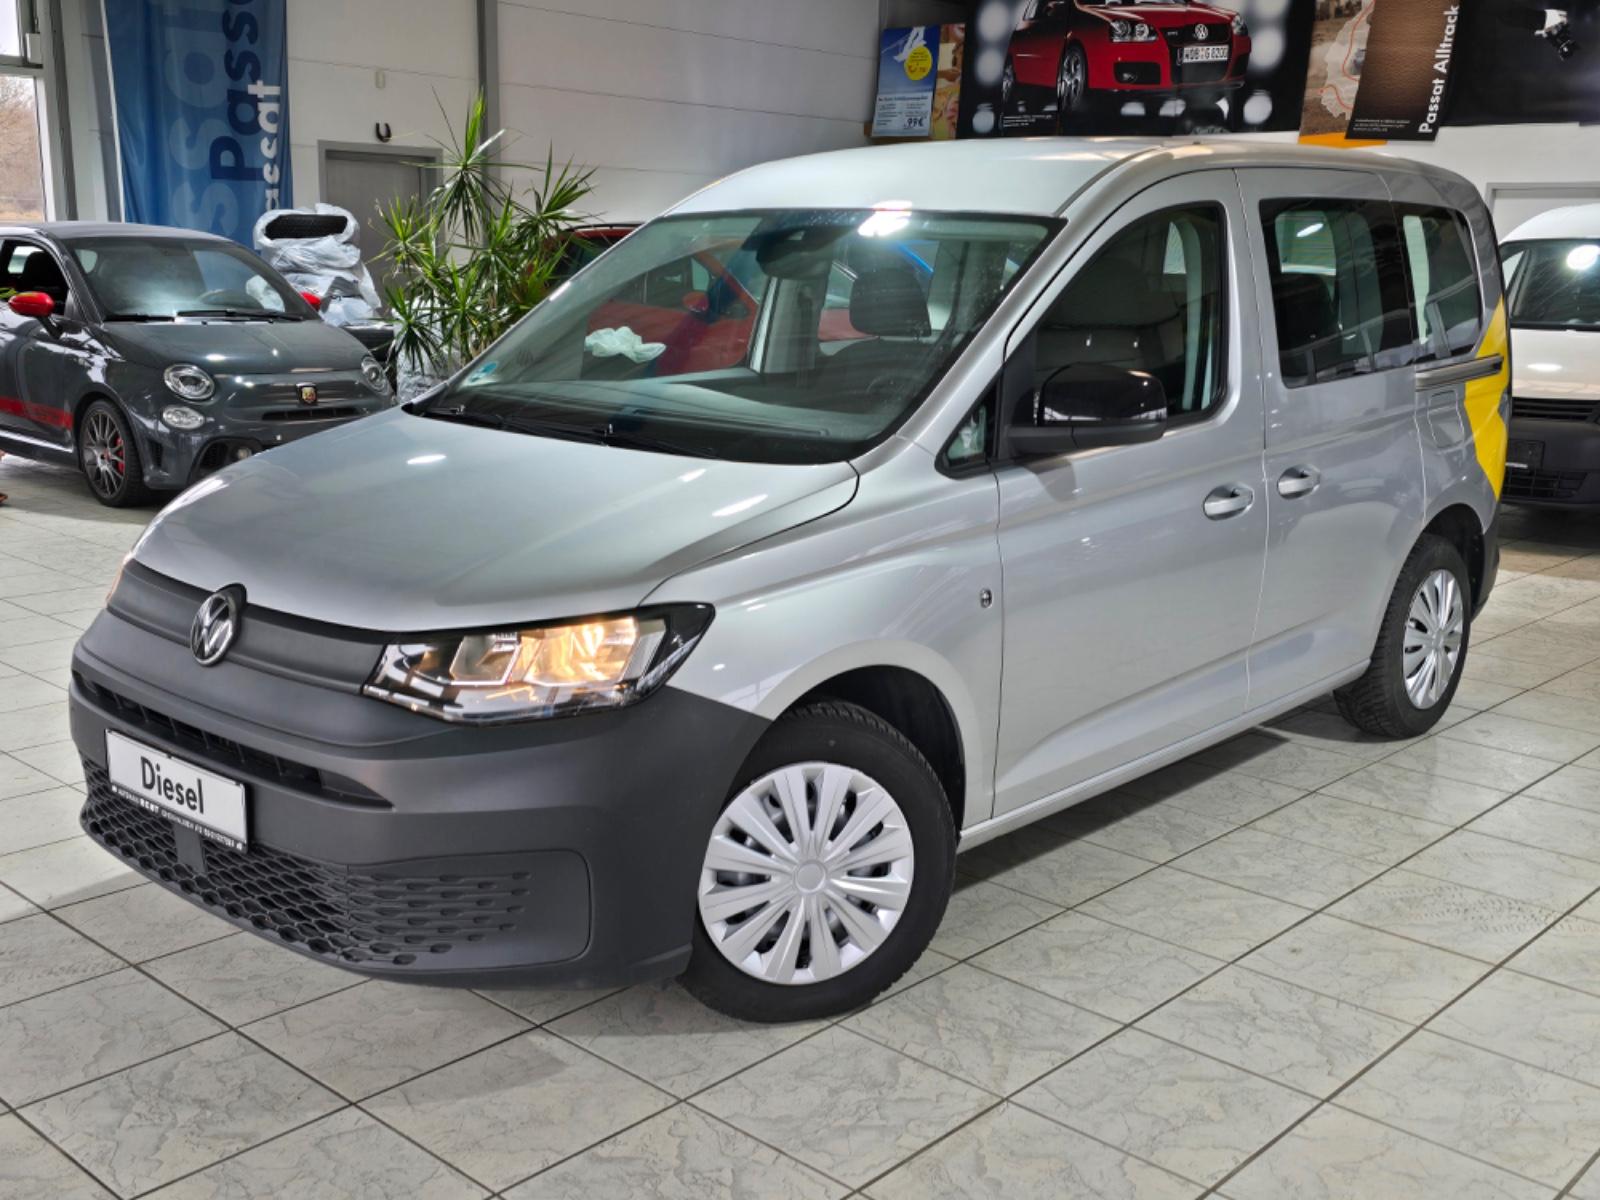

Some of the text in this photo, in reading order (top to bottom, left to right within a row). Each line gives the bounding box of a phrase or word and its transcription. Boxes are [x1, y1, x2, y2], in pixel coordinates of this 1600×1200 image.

[209, 0, 267, 181] Pass
[1418, 5, 1460, 133] Passat Alltrack
[140, 756, 205, 814] Diesel
